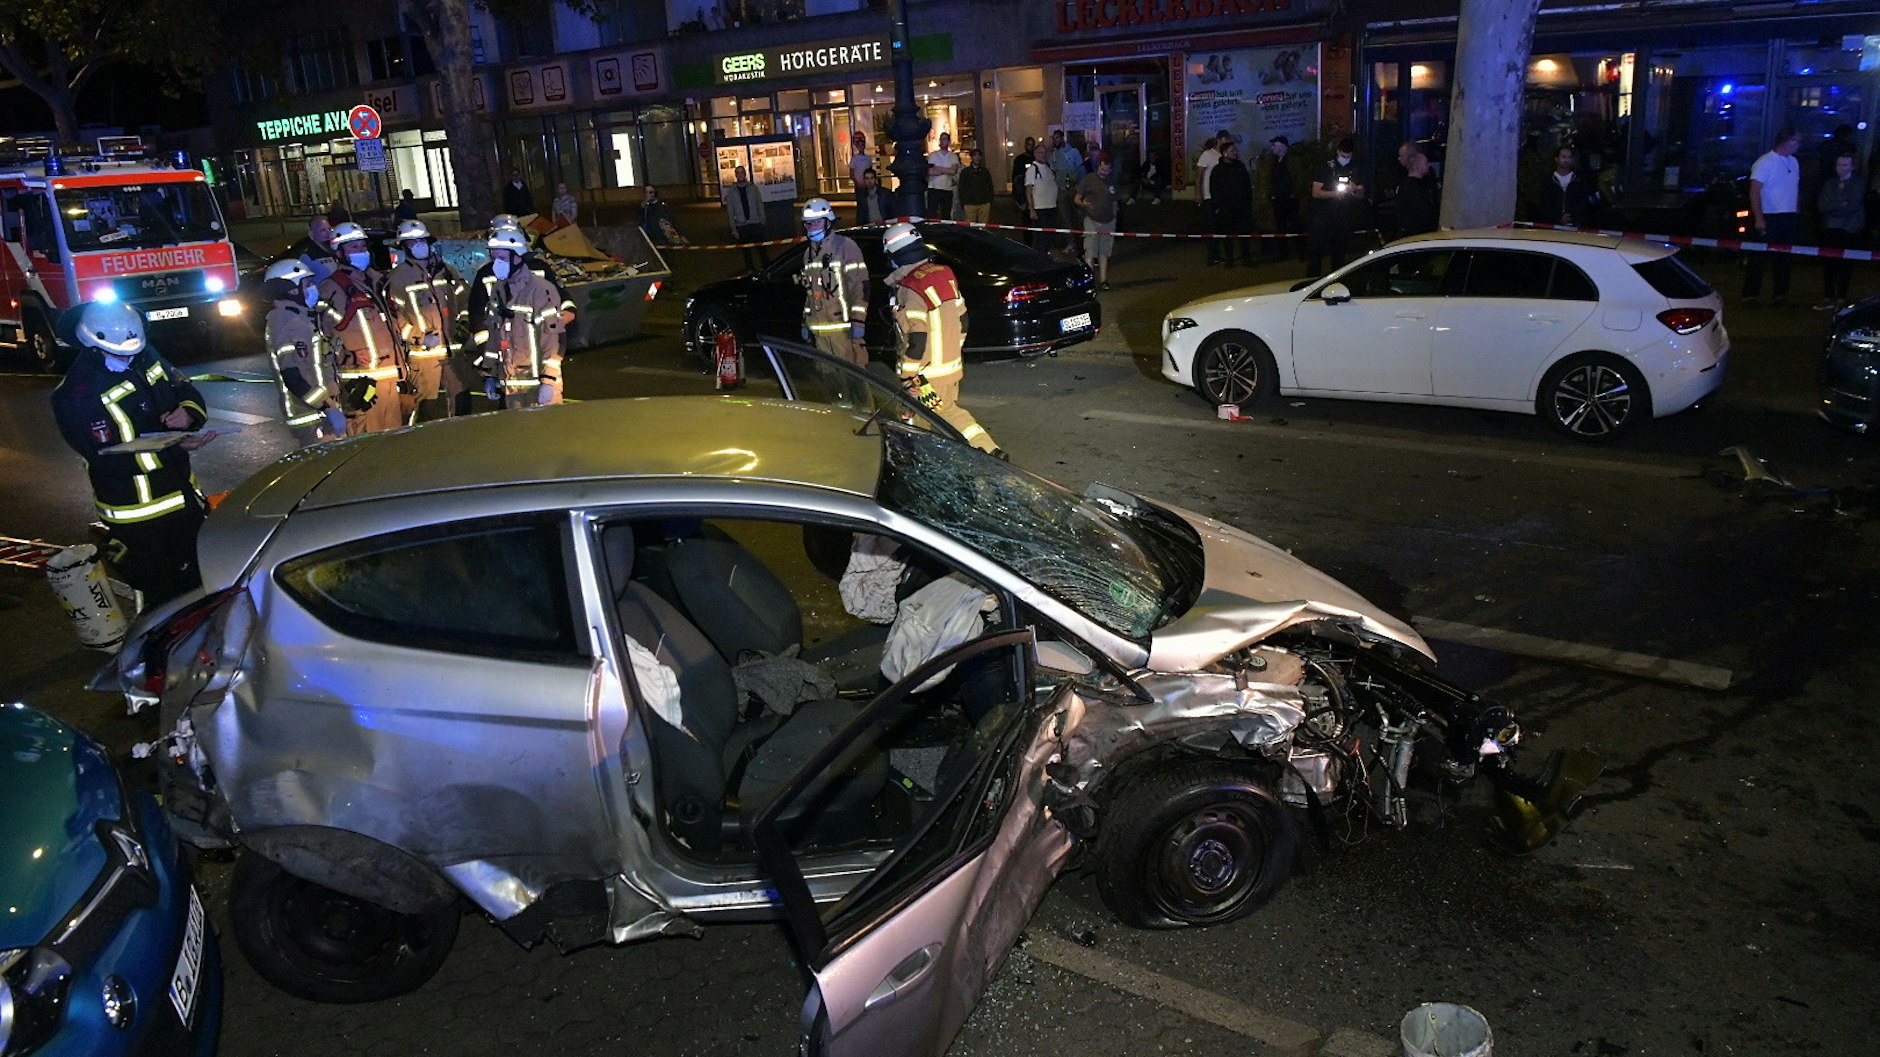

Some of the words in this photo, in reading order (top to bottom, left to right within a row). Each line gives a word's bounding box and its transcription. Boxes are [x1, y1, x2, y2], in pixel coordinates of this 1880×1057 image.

[722, 53, 766, 73] GEERS
[780, 41, 882, 71] HÖRGERÄTE
[257, 114, 322, 140] TEPPICHE
[324, 110, 353, 132] AYA
[102, 249, 205, 273] FEUERWEHR
[142, 277, 179, 288] MAN
